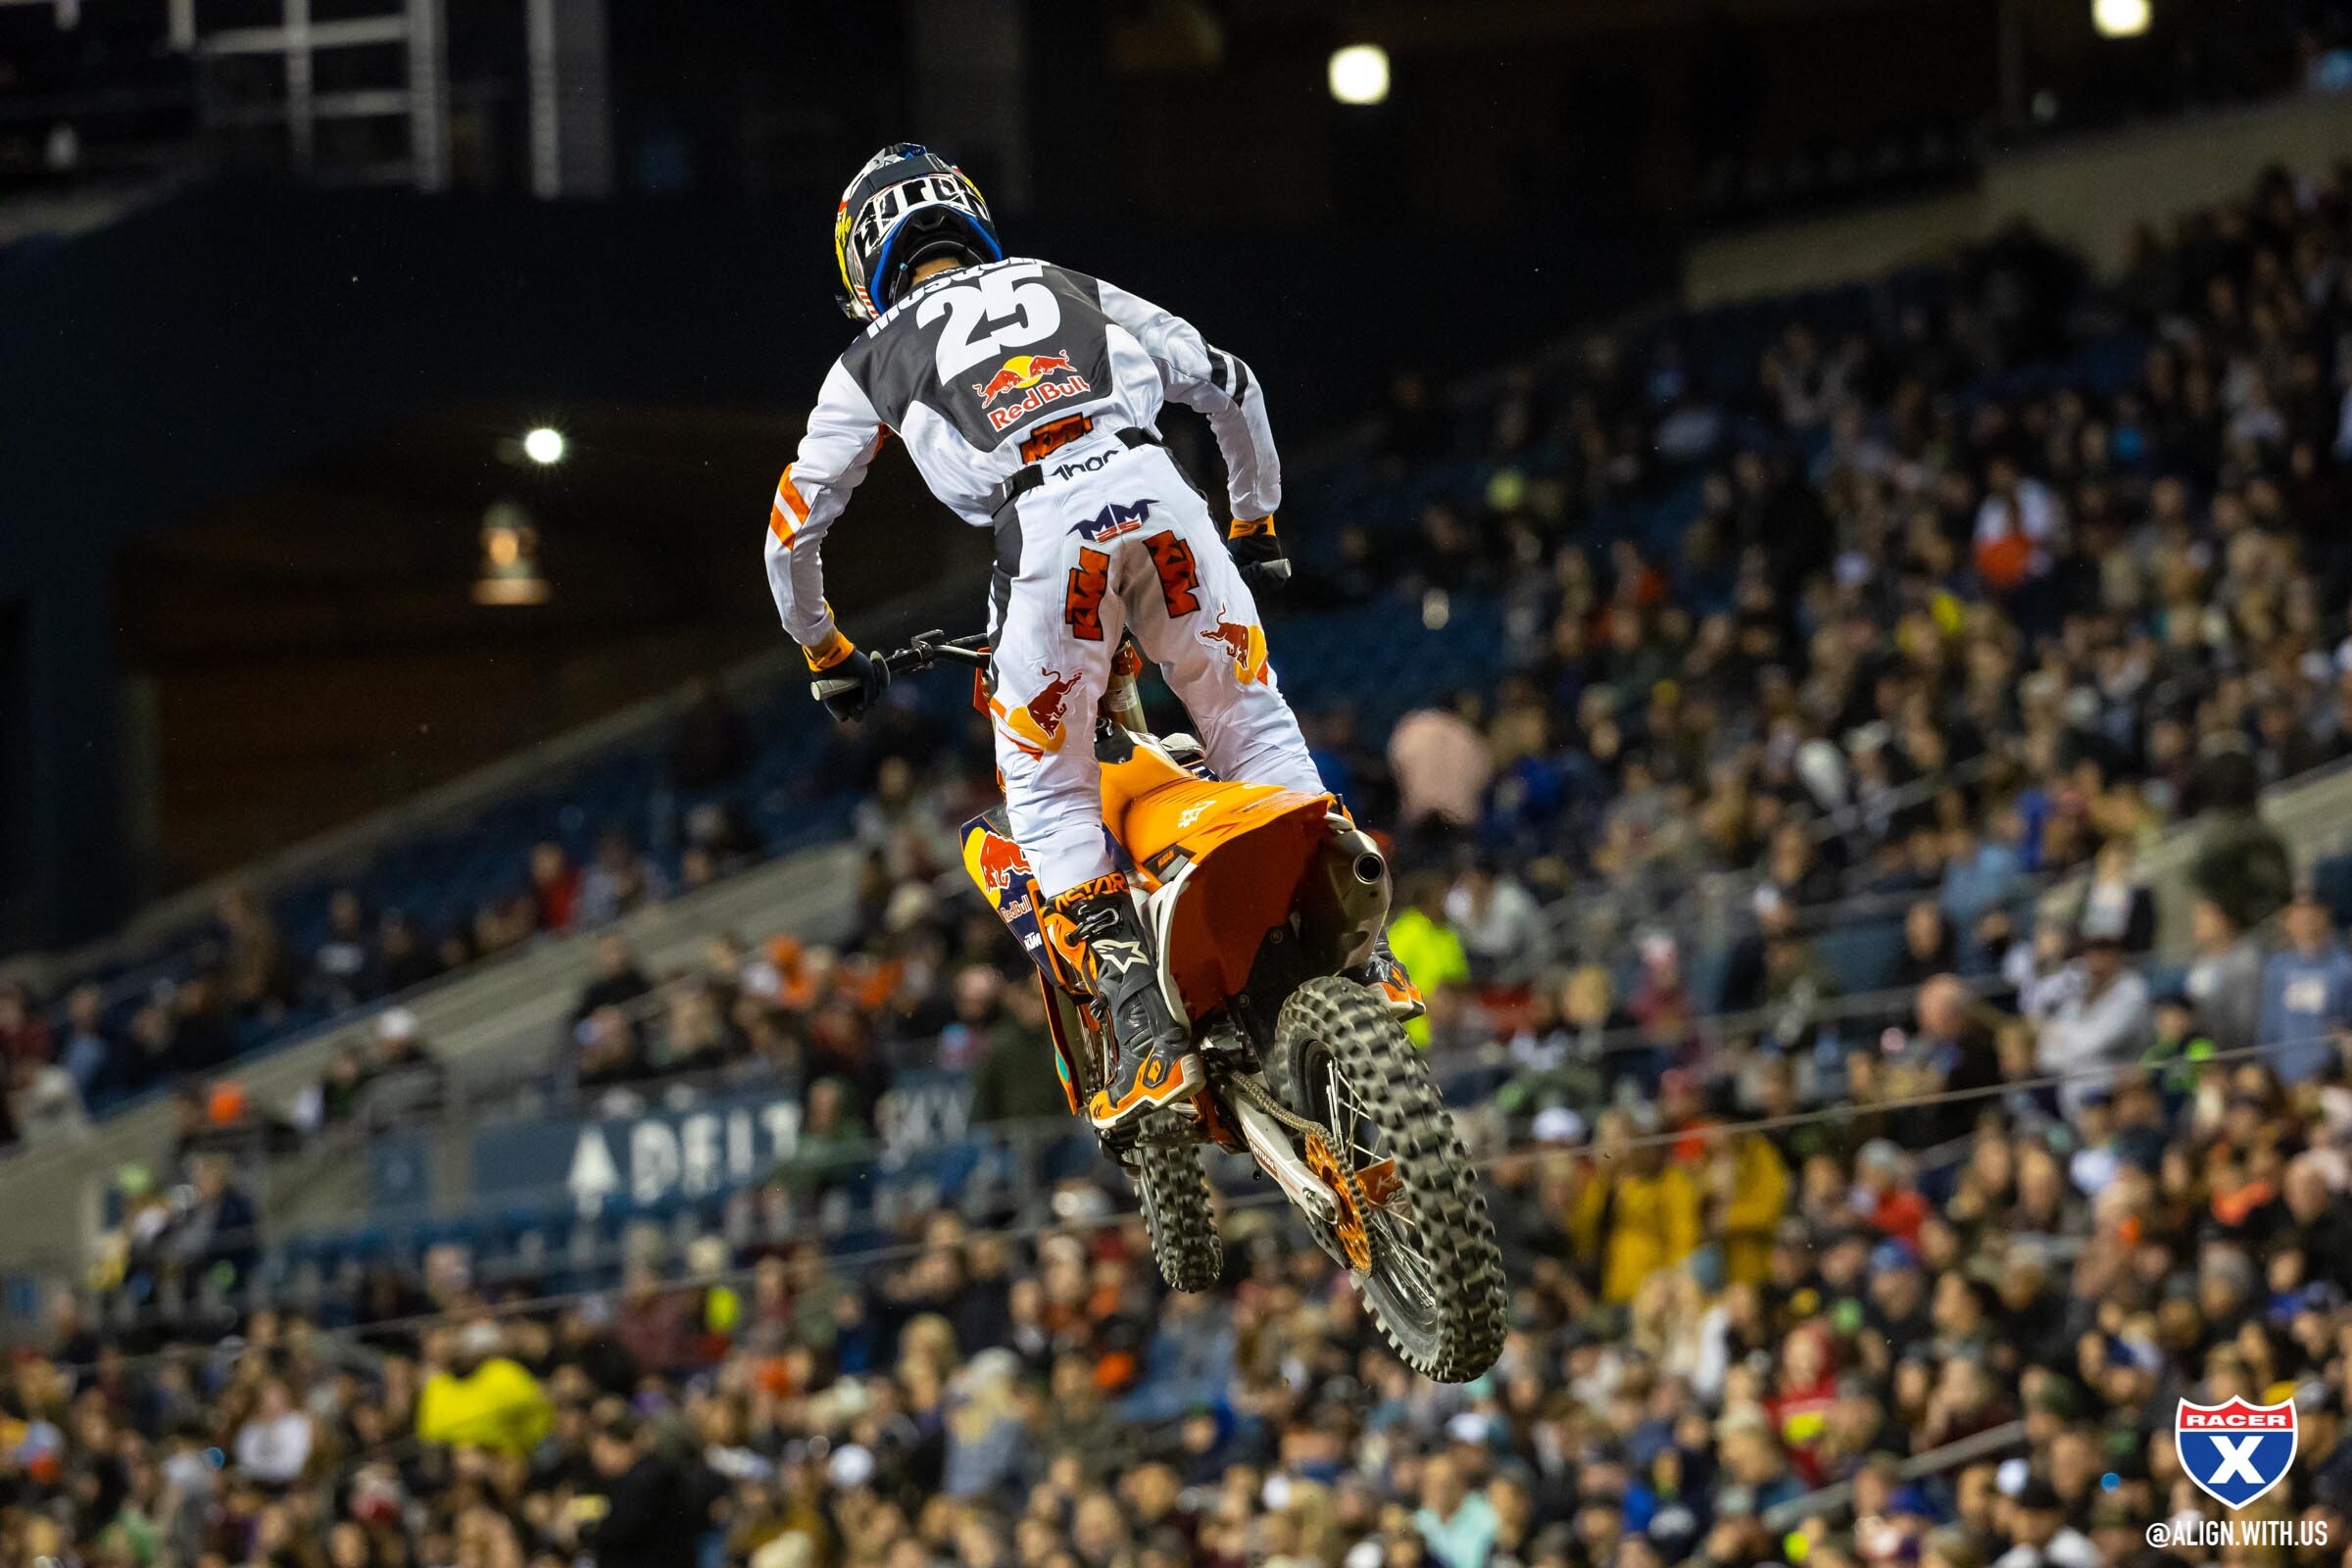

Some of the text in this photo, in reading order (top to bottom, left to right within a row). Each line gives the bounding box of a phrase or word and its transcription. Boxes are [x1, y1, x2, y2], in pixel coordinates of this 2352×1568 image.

[916, 265, 1060, 386] 25
[989, 375, 1091, 431] Red Bull
[1023, 932, 1044, 951] KTM
